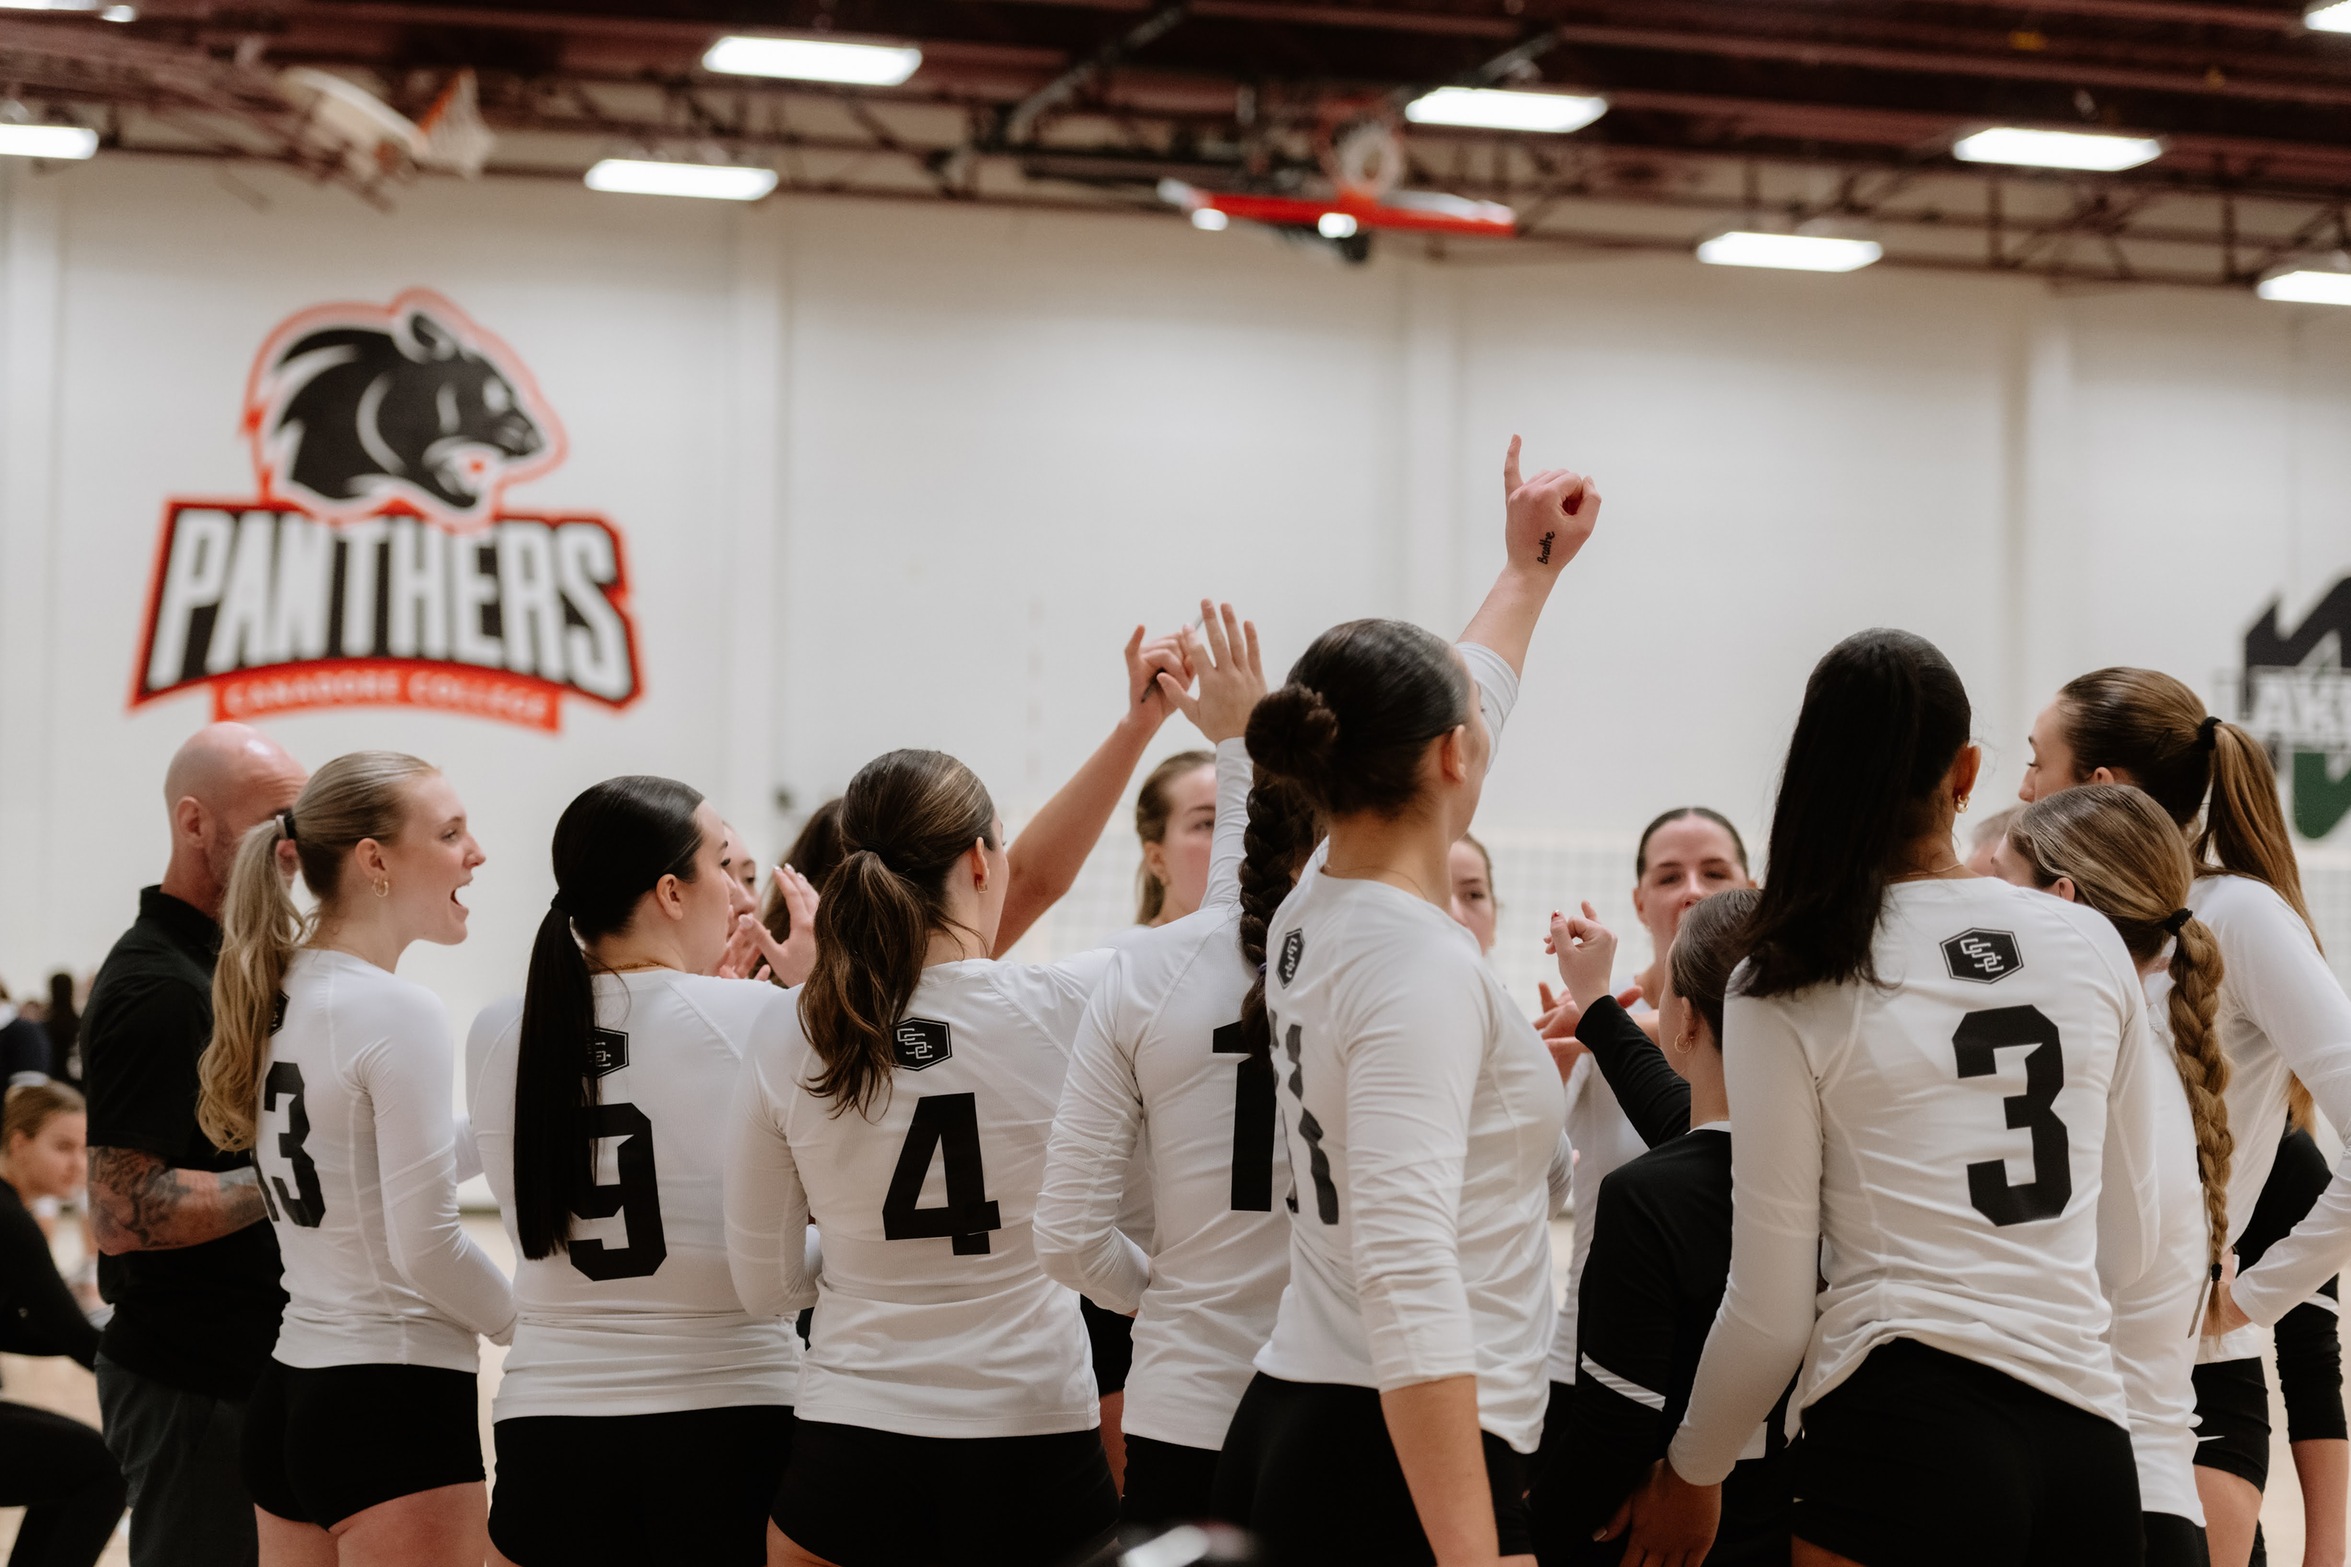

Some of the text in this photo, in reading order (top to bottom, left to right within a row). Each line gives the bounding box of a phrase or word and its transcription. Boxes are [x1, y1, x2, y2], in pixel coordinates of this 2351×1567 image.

[145, 507, 634, 700] PANTHERS
[567, 1102, 667, 1281] 9
[882, 1092, 1001, 1256] 4
[1952, 1004, 2072, 1227] 3
